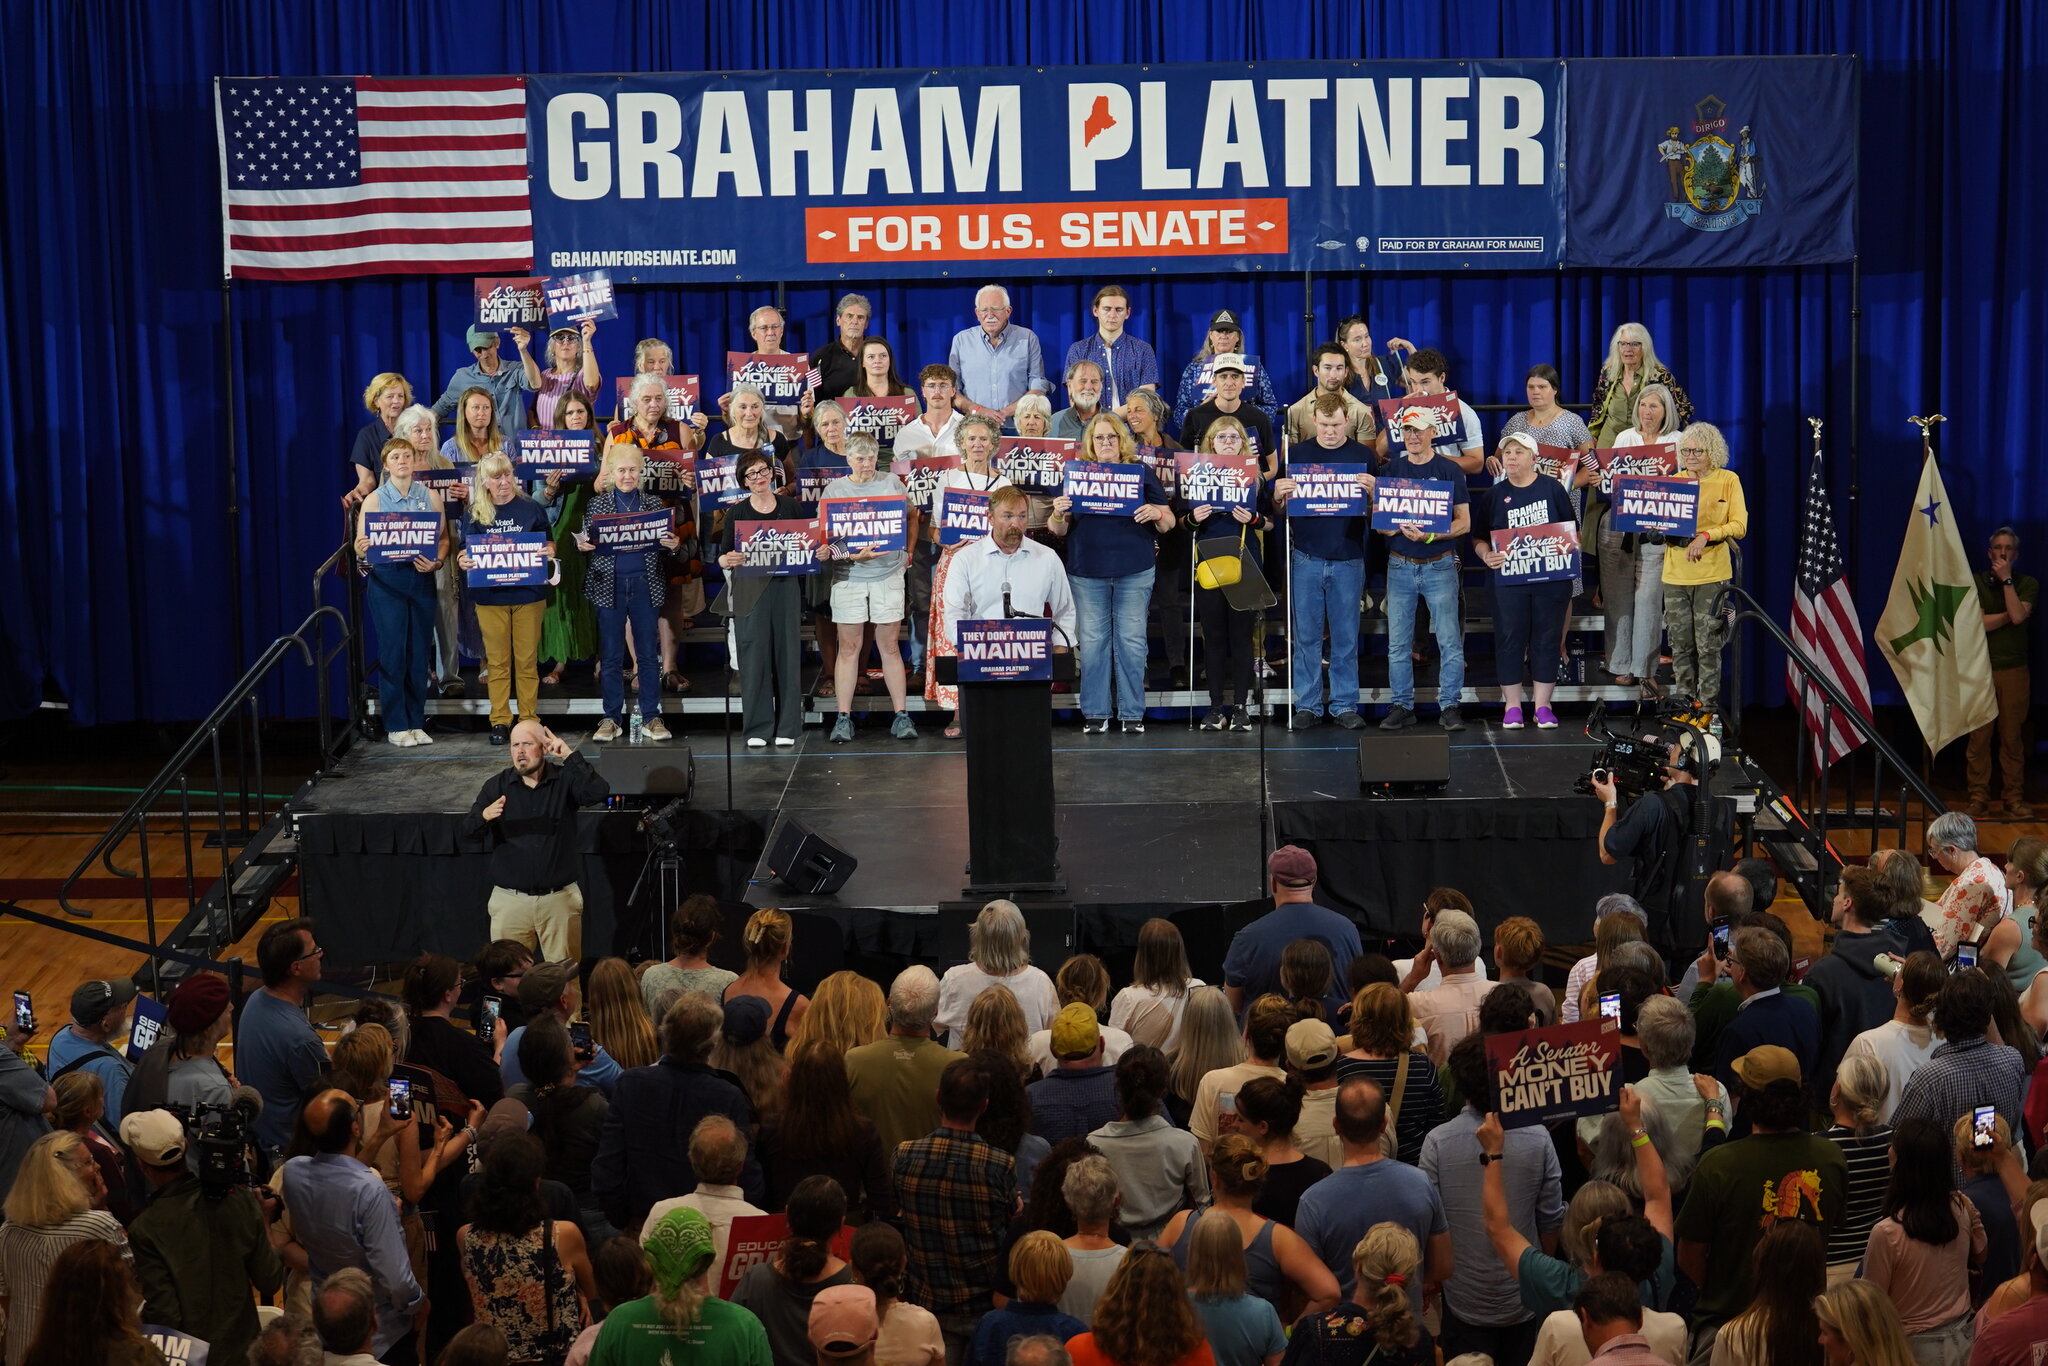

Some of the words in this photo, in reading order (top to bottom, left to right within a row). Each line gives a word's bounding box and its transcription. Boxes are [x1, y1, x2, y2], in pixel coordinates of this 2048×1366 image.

[1696, 119, 1725, 133] DIRIGO
[546, 85, 1023, 200] GRAHAM
[1068, 77, 1545, 191] PLATNER
[1692, 214, 1737, 228] MAINE
[848, 215, 942, 252] FOR
[958, 213, 1045, 250] U.S.
[1060, 209, 1246, 248] SENATE
[1382, 240, 1404, 250] PAID
[1406, 240, 1426, 250] FOR
[1428, 240, 1440, 250] BY
[1442, 240, 1484, 250] GRAHAM
[1486, 240, 1506, 249] FOR
[1508, 240, 1540, 248] MAINE
[551, 249, 736, 268] GRAHAMFORSENATE.COM
[488, 286, 500, 298] A
[505, 286, 541, 298] Senator
[548, 288, 566, 298] THEY
[568, 284, 589, 294] DON'T
[590, 278, 610, 290] KNOW
[480, 296, 545, 308] MONEY
[550, 288, 612, 312] MAINE
[480, 308, 518, 324] CAN'T
[522, 307, 545, 322] BUY
[740, 362, 754, 372] A
[755, 362, 796, 373] Senator
[733, 371, 802, 383] MONEY
[776, 384, 802, 396] BUY
[849, 405, 862, 416] A
[864, 404, 905, 416] Senator
[846, 414, 910, 426] MONEY
[520, 440, 538, 448] THEY
[540, 440, 562, 448] DON'T
[564, 440, 590, 448] KNOW
[521, 448, 590, 464] MAINE
[1005, 446, 1018, 459] A
[1020, 446, 1063, 460] Senator
[998, 458, 1065, 472] MONEY
[1186, 462, 1200, 474] A
[1202, 462, 1244, 476] Senator
[1536, 456, 1568, 468] enator
[1606, 456, 1621, 469] A
[1622, 455, 1665, 468] Senator
[700, 468, 718, 478] THEY
[720, 466, 736, 475] DON
[905, 468, 918, 481] A
[920, 466, 946, 478] Sena
[1069, 470, 1088, 480] THEY
[1089, 472, 1112, 480] DON'T
[1114, 474, 1140, 483] KNOW
[1292, 474, 1310, 482] THEY
[1312, 474, 1335, 482] DON'T
[1600, 464, 1671, 478] MONEY
[702, 476, 740, 494] MAI
[800, 478, 820, 486] THEY
[1180, 474, 1250, 487] MONEY
[1068, 480, 1138, 498] MAINE
[1180, 485, 1219, 501] CAN'T
[1222, 487, 1250, 502] BUY
[1292, 484, 1362, 498] MAINE
[1379, 488, 1398, 497] THEY
[1400, 489, 1423, 498] DON'T
[1424, 490, 1450, 500] KNOW
[1624, 489, 1642, 498] THEY
[1644, 490, 1668, 500] DON'T
[1670, 492, 1695, 503] KNOW
[948, 503, 968, 512] THEY
[1378, 498, 1448, 516] MAINE
[1508, 500, 1548, 520] GRAHAM
[1622, 498, 1694, 519] MAINE
[496, 518, 514, 526] Voted
[832, 512, 850, 521] THEY
[852, 511, 876, 520] DON'T
[878, 510, 902, 519] KNOW
[948, 512, 992, 532] MAI
[1508, 510, 1548, 529] PLATNER
[369, 522, 388, 530] THEY
[389, 522, 410, 530] DON'T
[412, 521, 437, 530] KNOW
[503, 524, 523, 533] Likely
[620, 523, 642, 532] DON'T
[644, 518, 668, 530] KNOW
[832, 520, 902, 537] MAINE
[370, 530, 434, 546] MAINE
[600, 526, 669, 544] MAINE
[749, 530, 764, 542] A
[765, 528, 808, 542] Senator
[471, 544, 491, 553] THEY
[492, 544, 516, 552] DON'T
[517, 543, 543, 552] KNOW
[741, 540, 814, 552] MONEY
[1506, 536, 1524, 551] A
[1526, 534, 1565, 547] Senator
[1500, 542, 1572, 559] MONEY
[472, 552, 543, 569] MAINE
[744, 550, 784, 567] CAN'T
[786, 550, 814, 566] BUY
[1501, 557, 1542, 576] CAN'T
[1548, 554, 1573, 572] BUY
[962, 632, 984, 642] THEY
[986, 631, 1014, 641] DON'T
[1016, 630, 1046, 640] KNOW
[964, 642, 1046, 660] MAINE
[1509, 1046, 1530, 1069] A
[1534, 1041, 1602, 1063] Senator
[1498, 1052, 1611, 1088] MONEY
[1500, 1078, 1564, 1113] CAN'T
[1569, 1070, 1612, 1102] BUY
